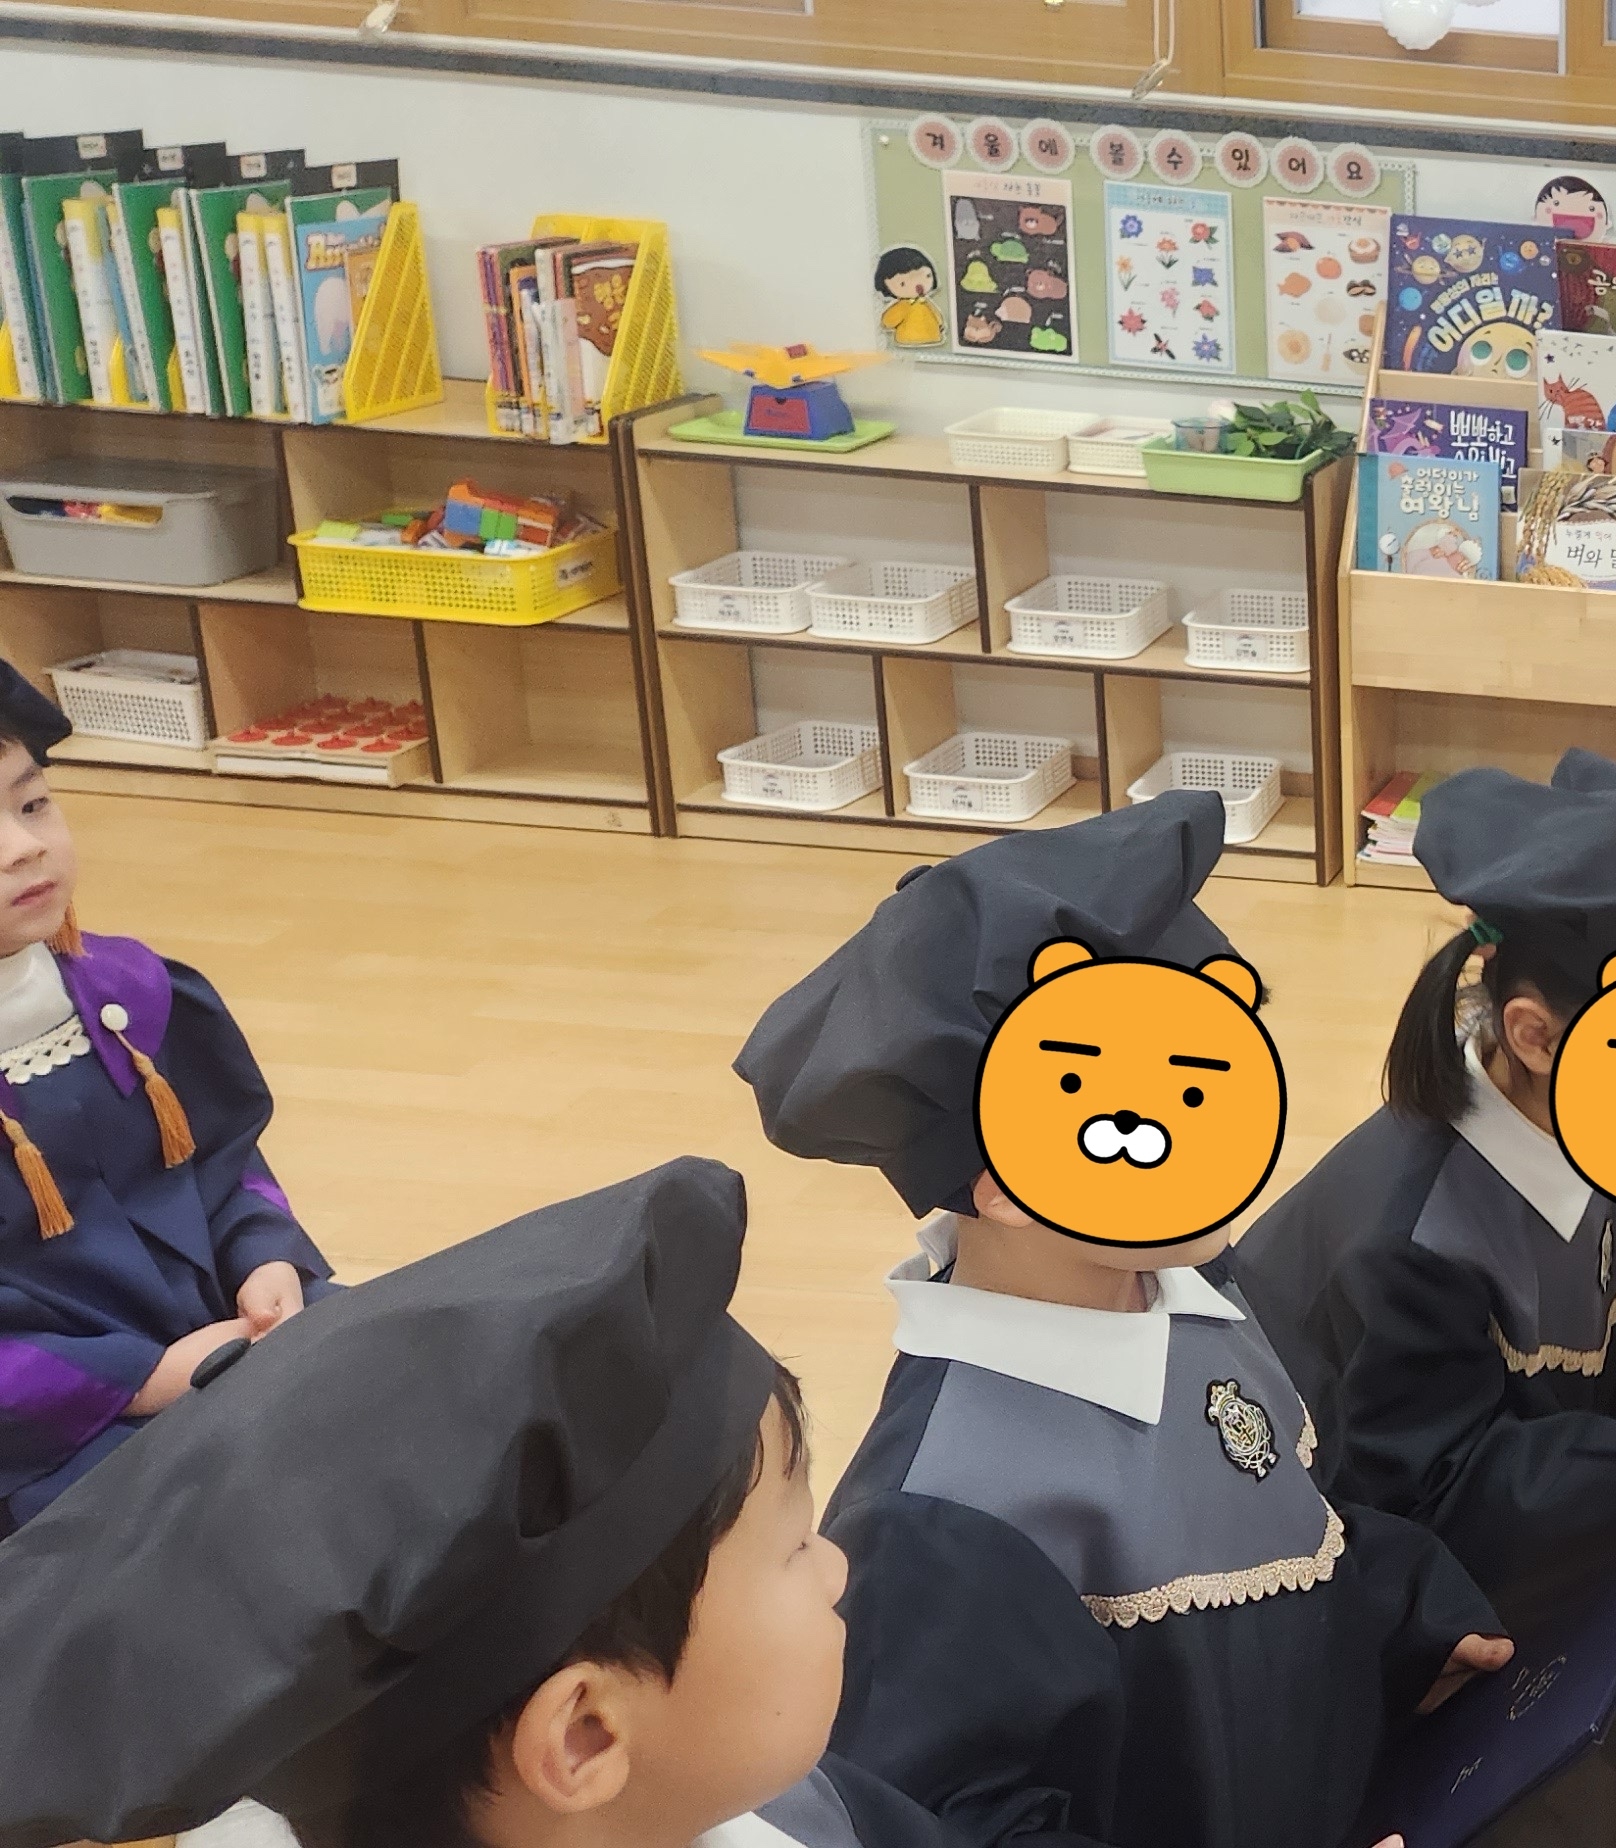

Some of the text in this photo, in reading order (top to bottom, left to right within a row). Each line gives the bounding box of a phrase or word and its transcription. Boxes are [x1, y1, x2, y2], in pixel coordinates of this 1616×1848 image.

[1450, 410, 1516, 447] 뽀뽀하고
[1400, 492, 1480, 522] 여왕님
[1566, 543, 1603, 569] 벼와
